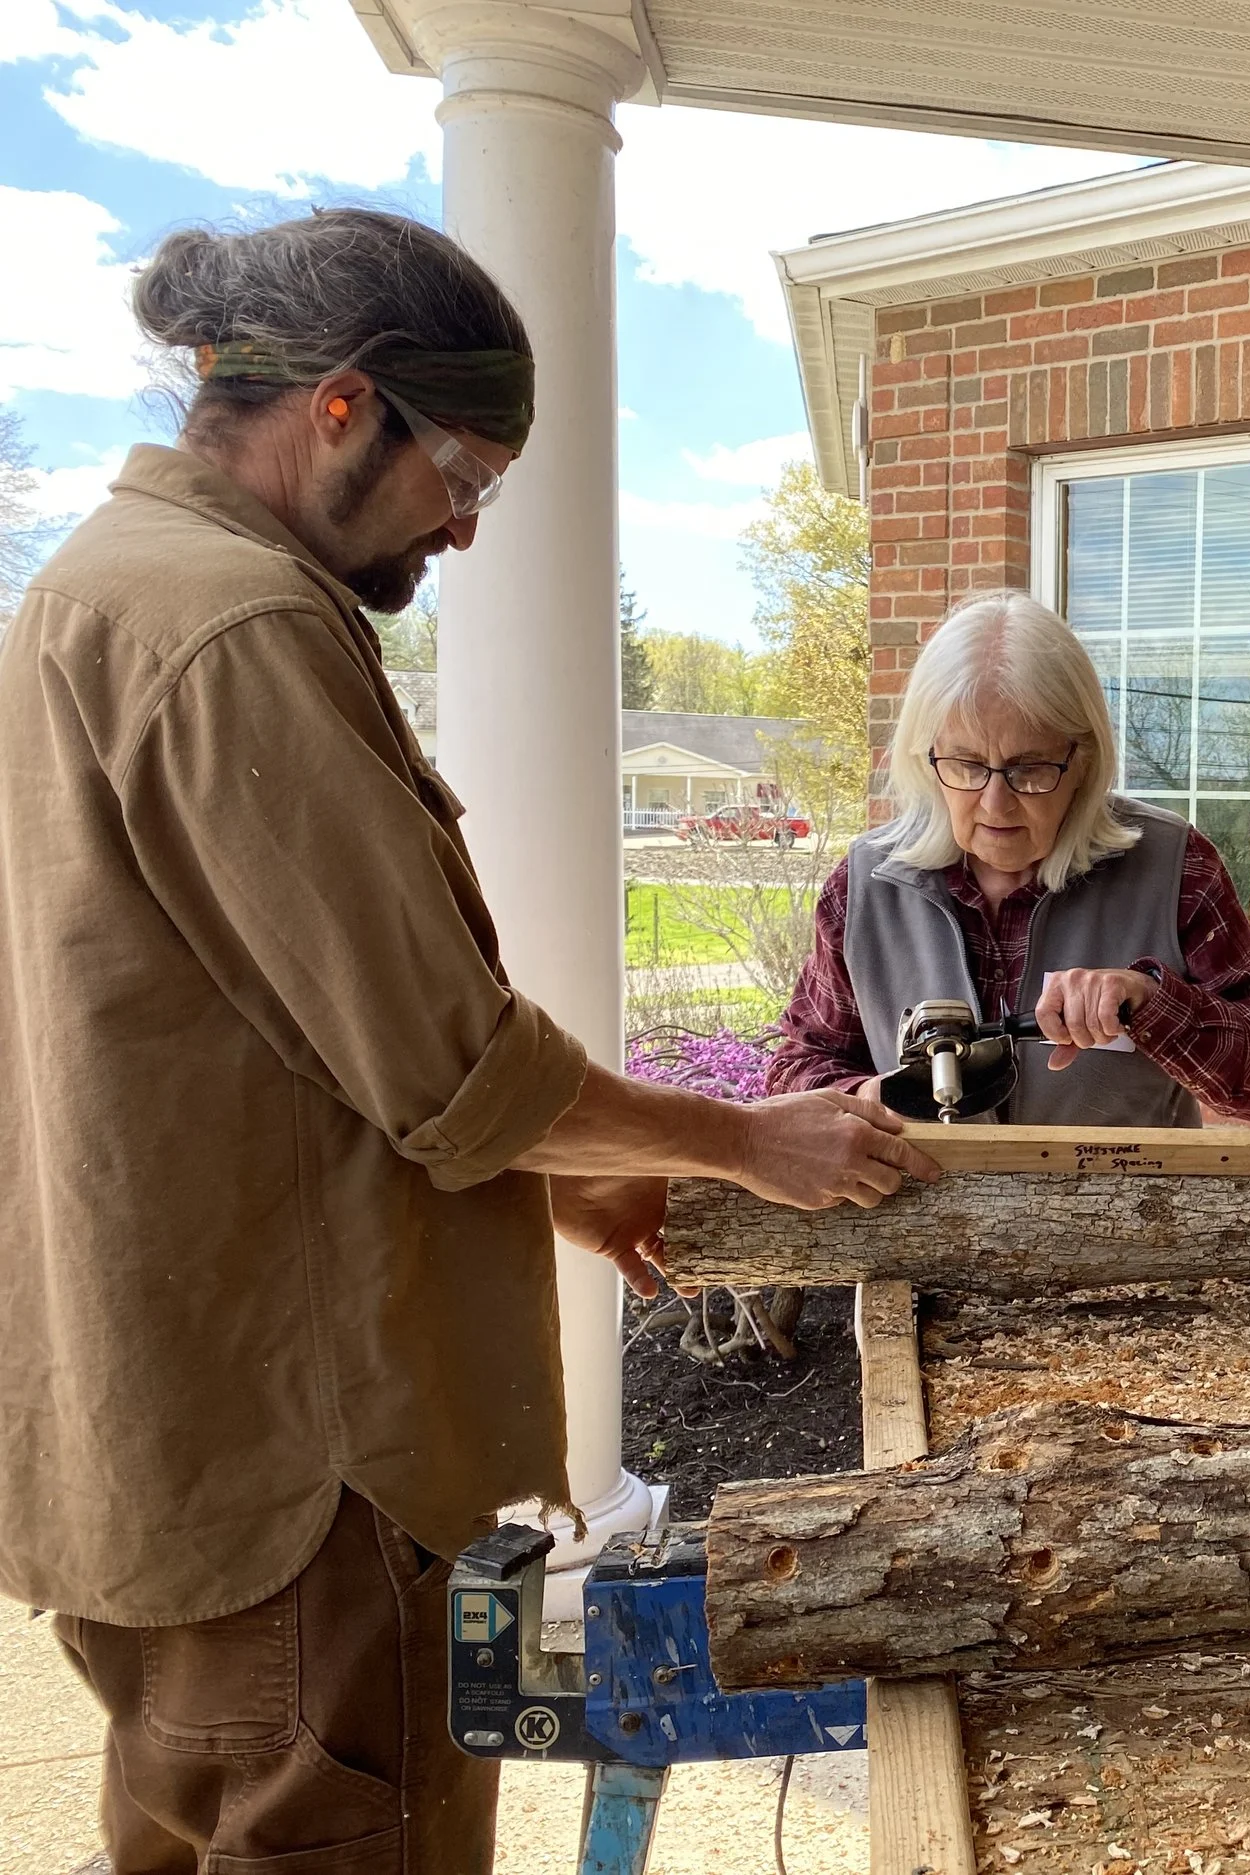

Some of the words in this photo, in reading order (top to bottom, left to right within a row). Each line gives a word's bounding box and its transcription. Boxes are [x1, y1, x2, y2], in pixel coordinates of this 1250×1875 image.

[1111, 1157, 1163, 1172] Spacing
[463, 1611, 488, 1620] 2X4
[526, 1717, 548, 1739] K
